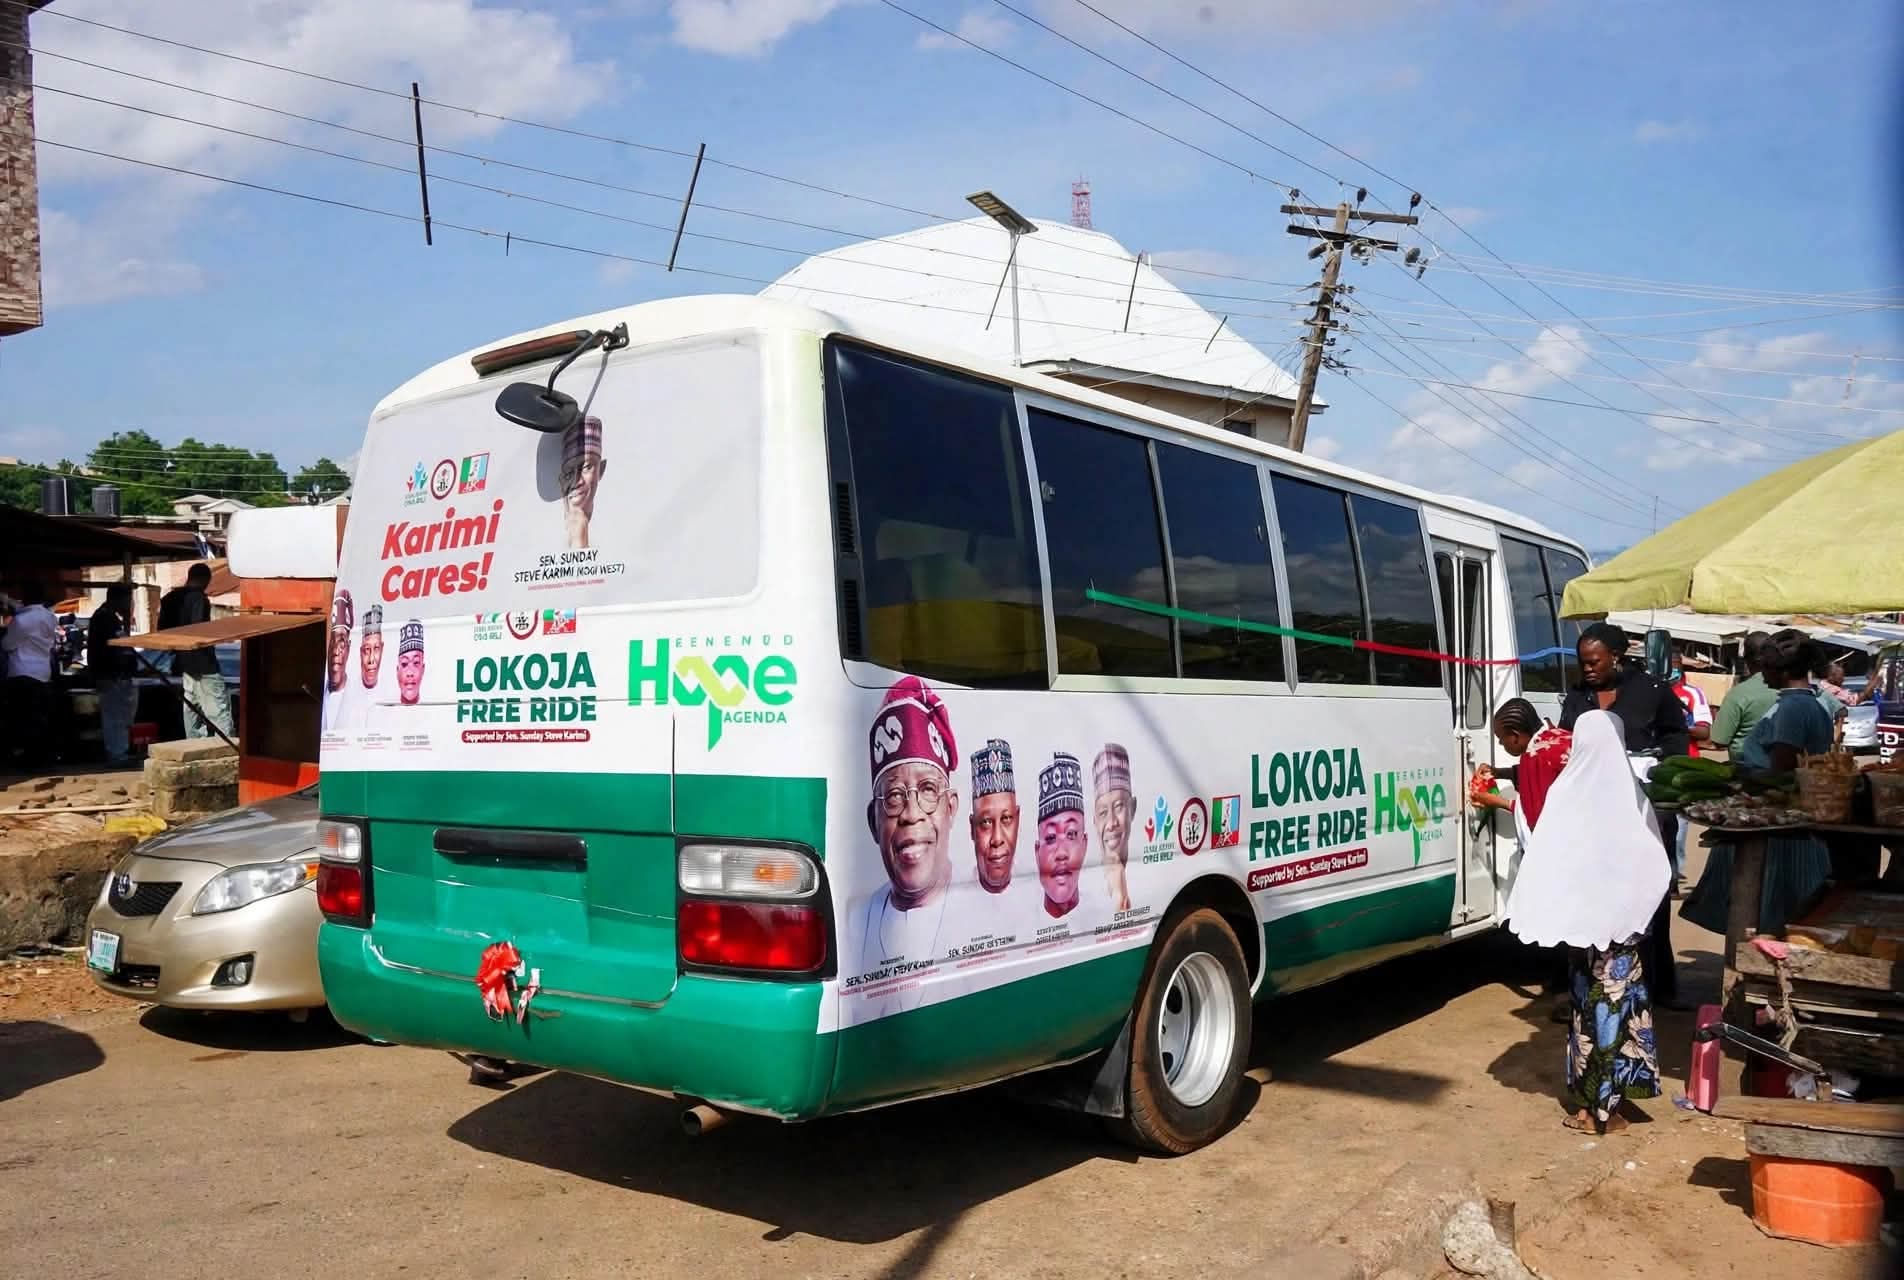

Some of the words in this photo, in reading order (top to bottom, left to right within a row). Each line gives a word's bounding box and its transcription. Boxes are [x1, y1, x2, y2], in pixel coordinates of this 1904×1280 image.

[381, 499, 504, 560] Karimi
[381, 552, 494, 602] Cares!
[514, 569, 541, 583] STEVE
[542, 566, 574, 580] KARIMI
[539, 555, 558, 567] SEN.
[560, 550, 598, 565] SUNDAY
[456, 651, 597, 693] LOKOJA
[627, 638, 798, 752] Hope
[457, 697, 521, 723] FREE
[530, 695, 597, 722] RIDE
[723, 711, 788, 724] AGENDA
[1250, 747, 1367, 809] LOKOJA
[1249, 816, 1303, 862] FREE
[1316, 806, 1368, 849] RIDE
[1374, 771, 1446, 866] Hope
[1286, 866, 1295, 881] by
